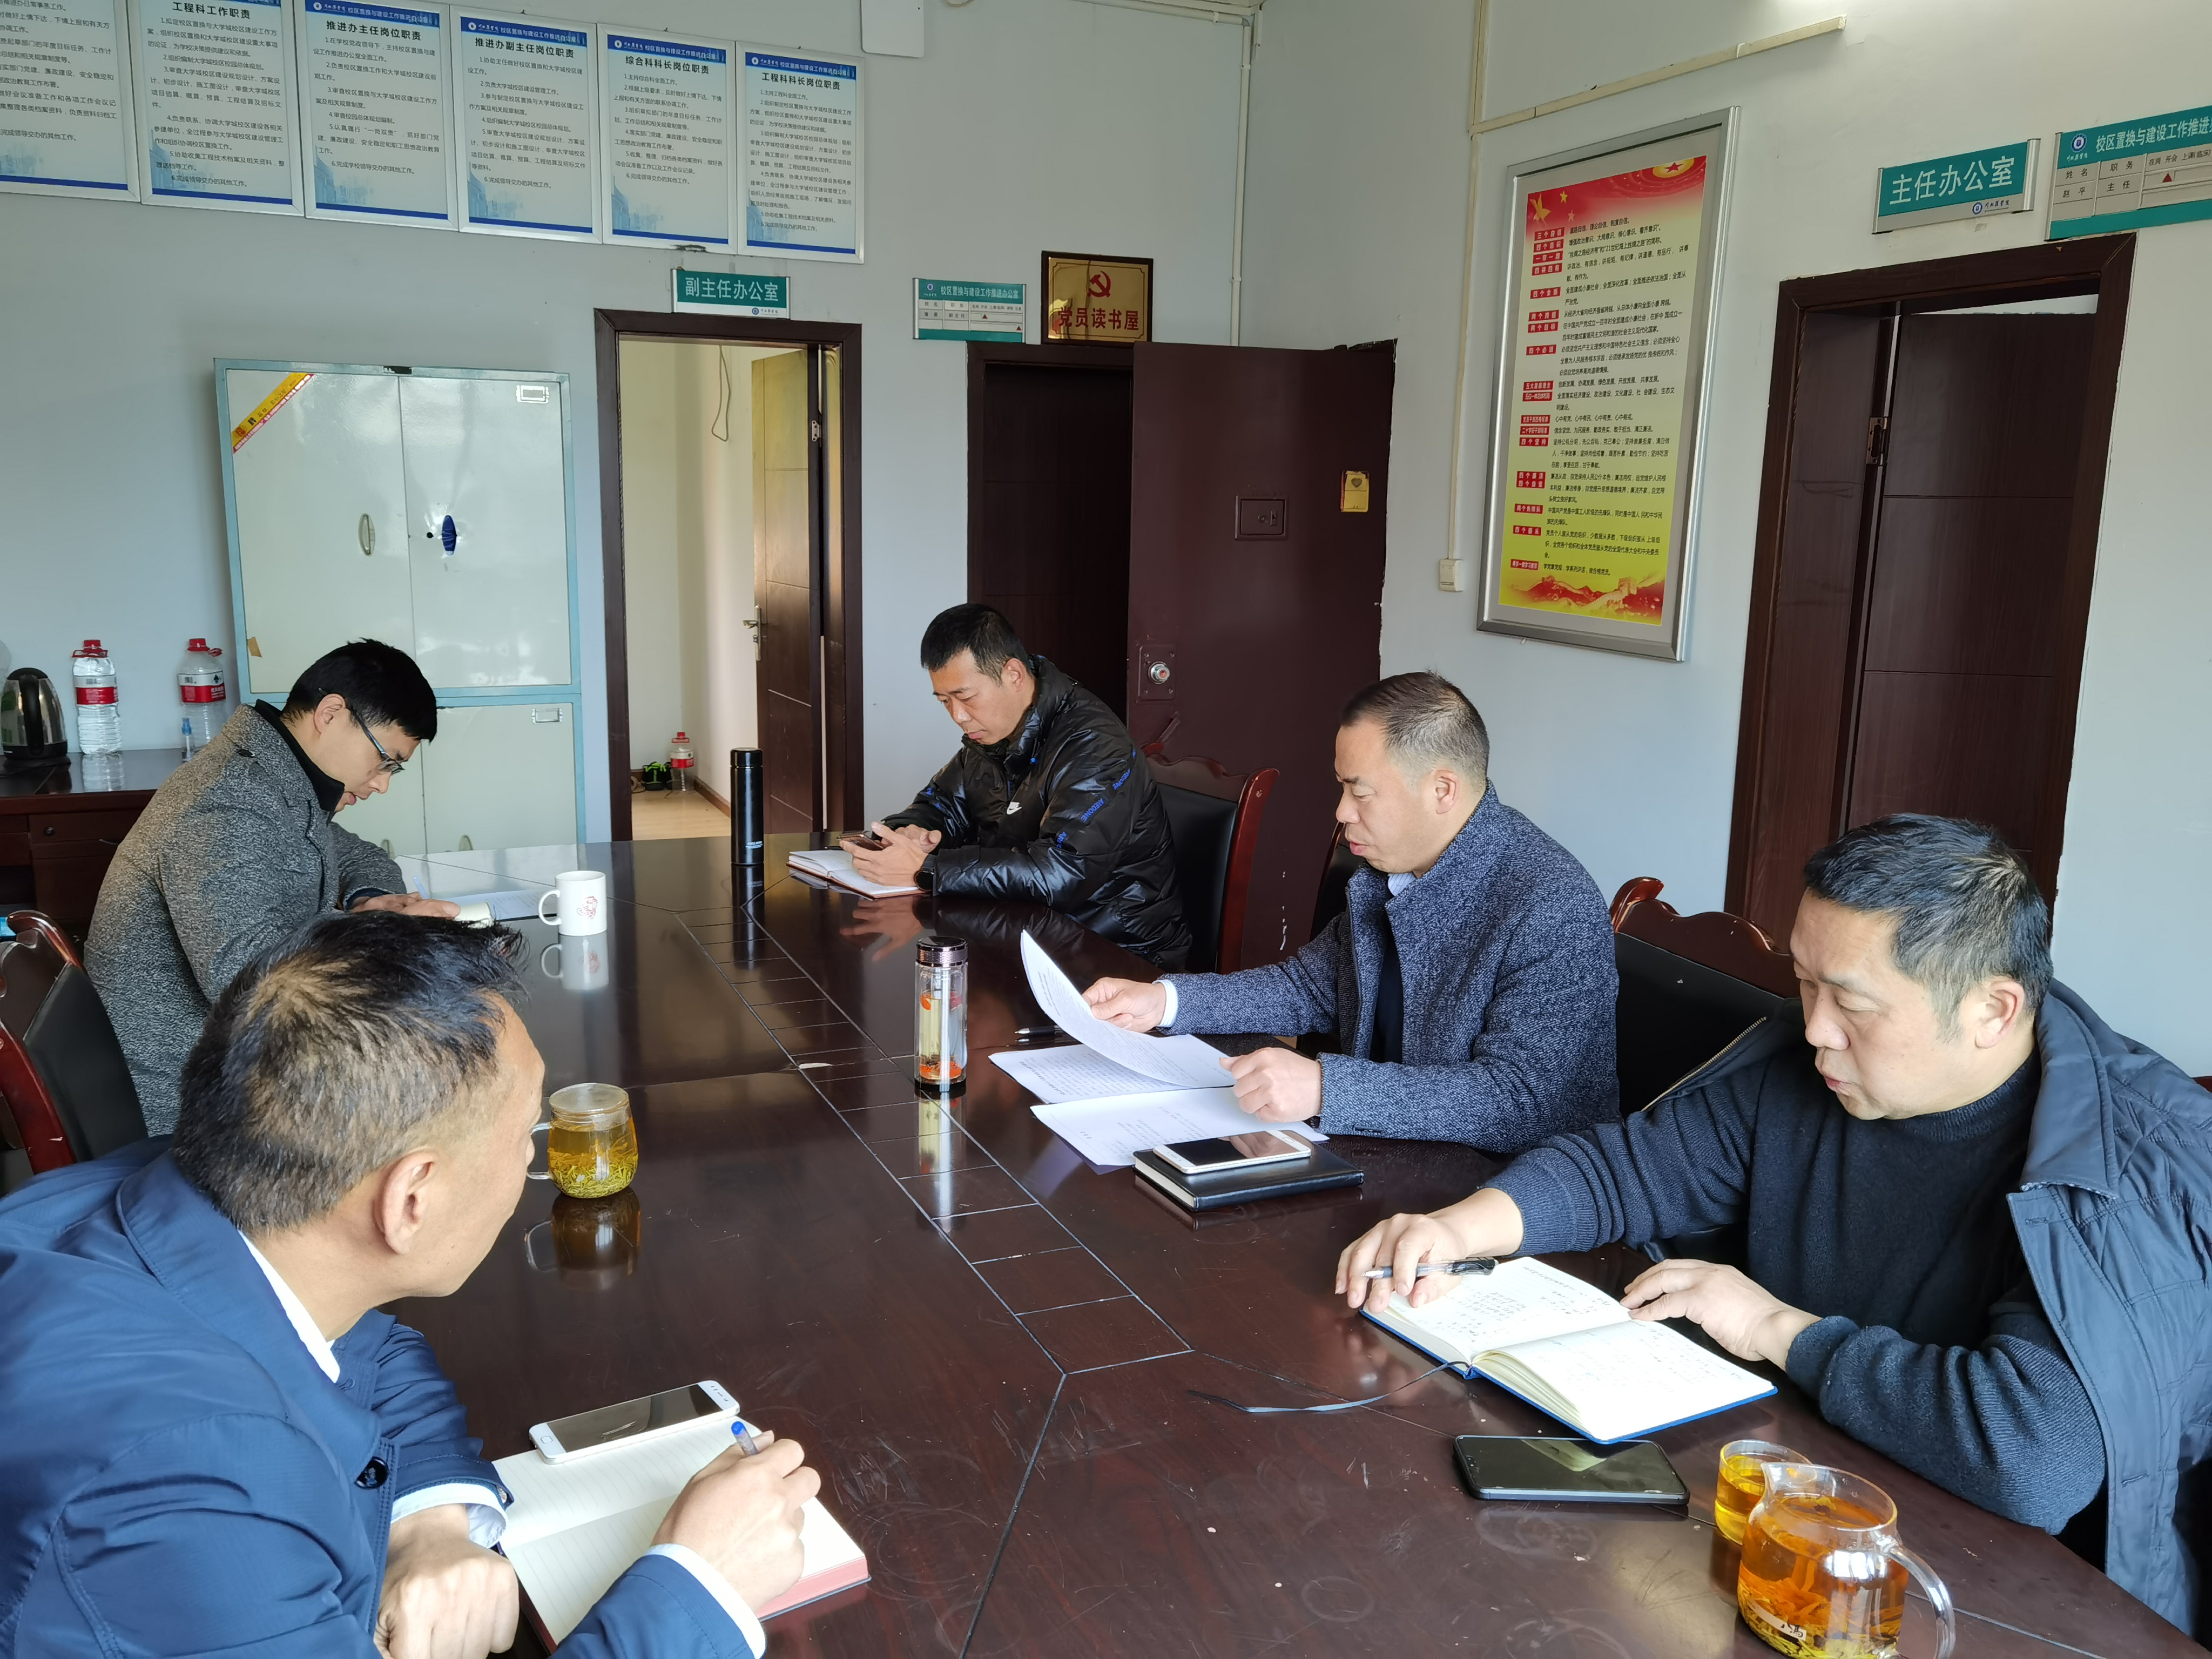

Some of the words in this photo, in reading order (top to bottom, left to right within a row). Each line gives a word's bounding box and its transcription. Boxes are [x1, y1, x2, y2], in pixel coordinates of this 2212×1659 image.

[172, 2, 251, 19] 工程科工作职责
[326, 20, 420, 41] 推进办主任岗位职责
[475, 37, 574, 58] 推进办副主任岗位职责
[625, 56, 709, 74] 综合科科长岗位职责
[761, 72, 840, 90] 工程科科长岗位职责
[1890, 156, 2014, 205] 主任办公室
[2066, 168, 2088, 179] 姓名
[2107, 180, 2130, 192] 主任
[685, 277, 778, 301] 副主任办公室
[941, 285, 1019, 299] 校区置换与建设工作推进办公室
[1057, 307, 1139, 331] 党员读书屋
